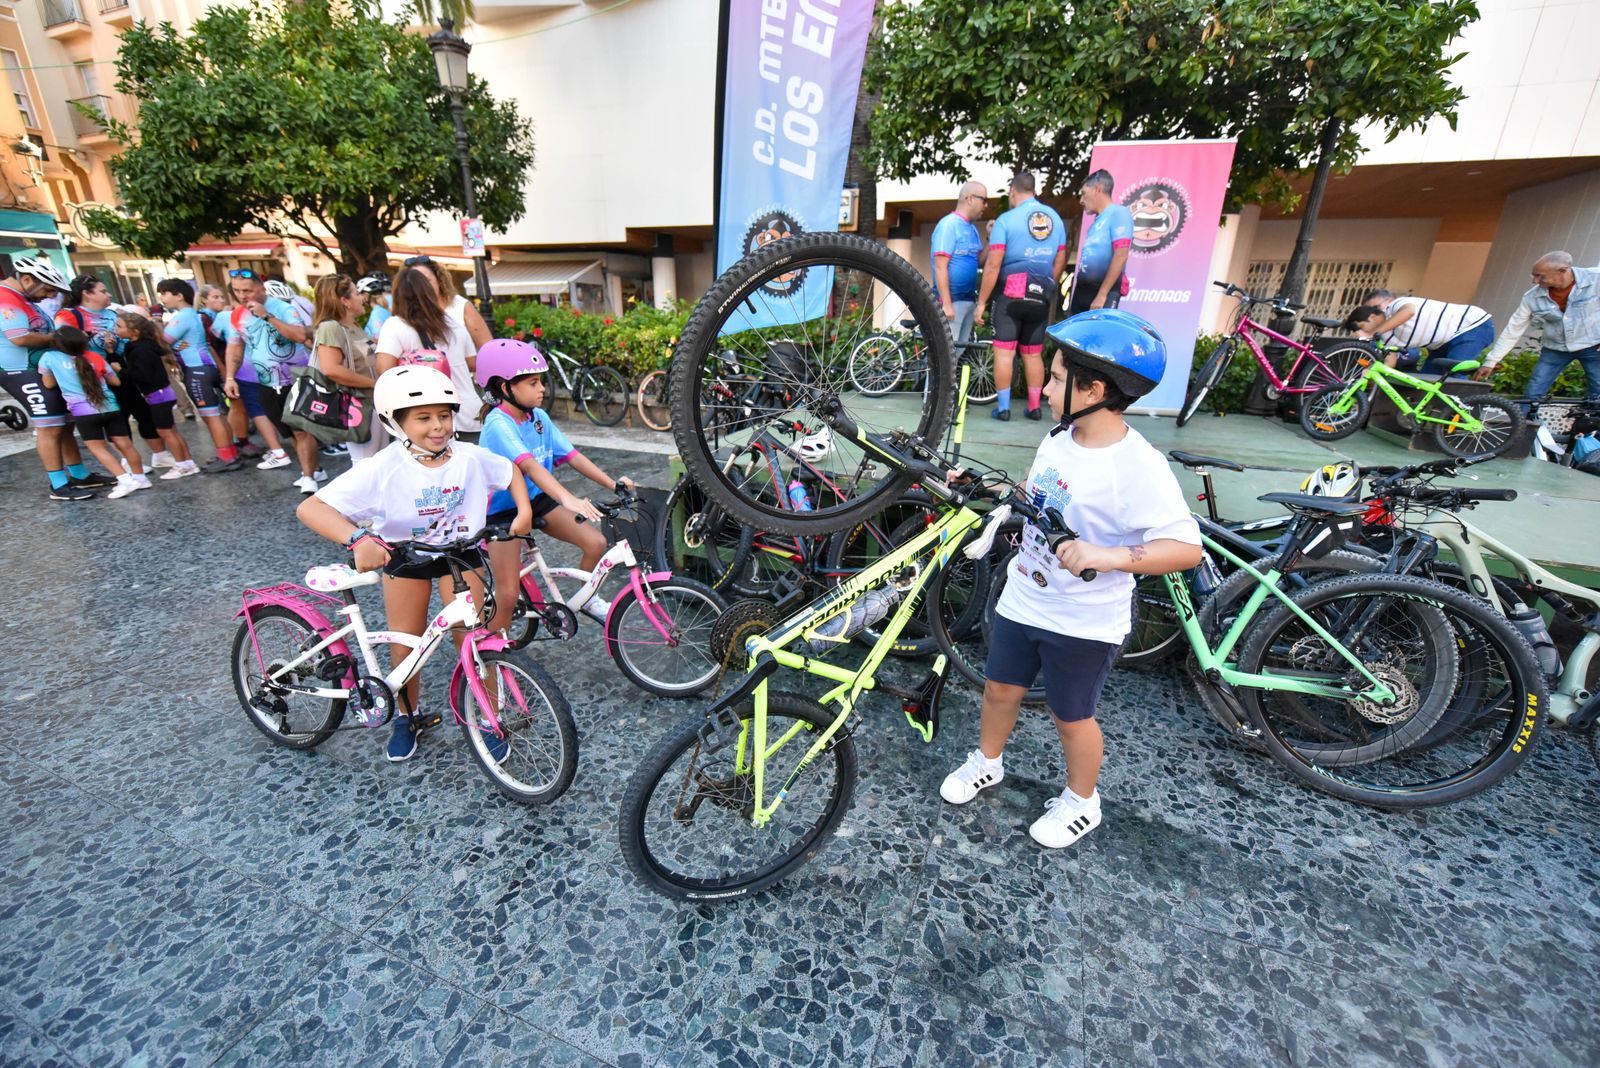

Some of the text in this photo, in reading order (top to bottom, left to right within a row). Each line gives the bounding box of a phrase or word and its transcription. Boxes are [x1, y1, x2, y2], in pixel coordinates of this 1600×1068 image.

[752, 102, 778, 167] C.D.
[779, 75, 824, 181] LOS
[21, 382, 48, 415] UCM
[801, 560, 905, 634] ROCKRIDER
[1512, 692, 1538, 753] MAXXIS
